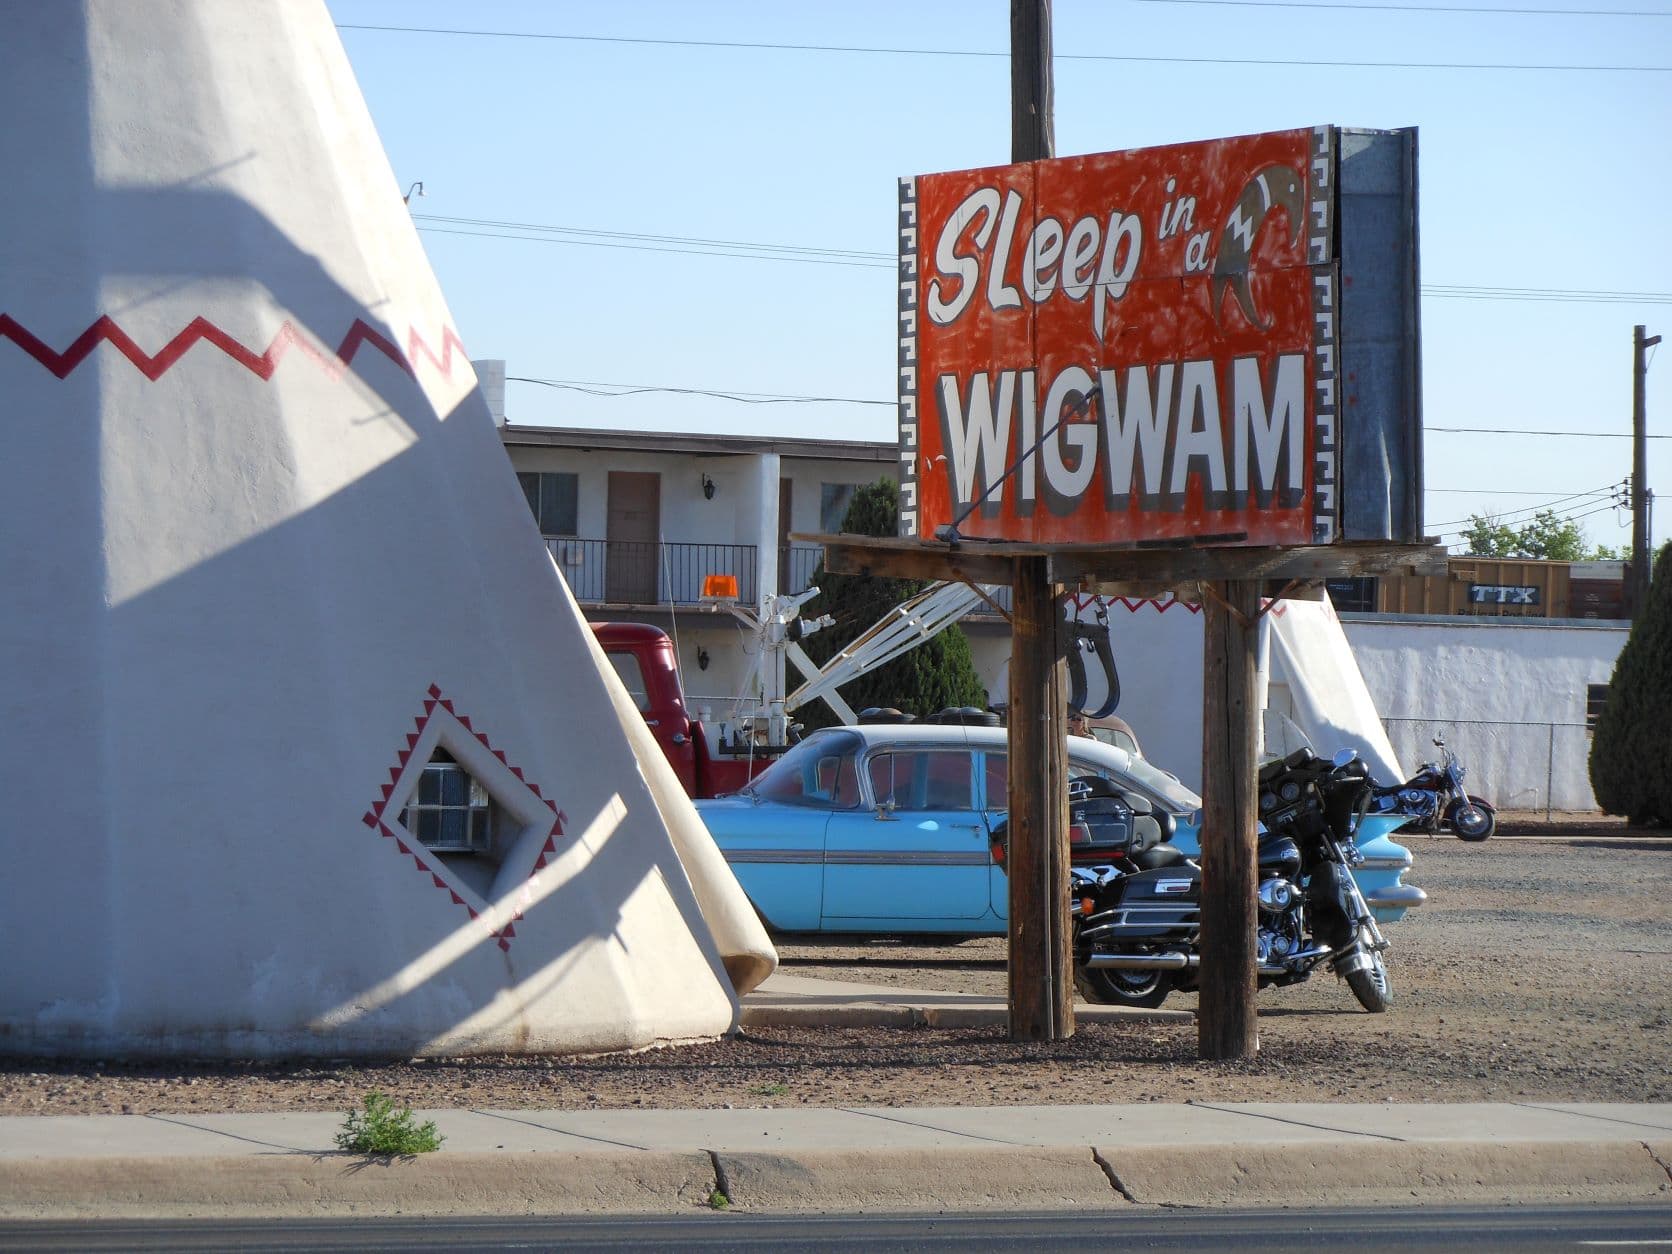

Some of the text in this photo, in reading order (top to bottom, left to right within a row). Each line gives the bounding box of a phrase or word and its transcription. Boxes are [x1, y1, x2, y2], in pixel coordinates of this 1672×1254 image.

[1158, 177, 1197, 240] in
[1185, 230, 1211, 272] a
[939, 353, 1305, 505] WIGWAM
[1471, 585, 1537, 603] TTX
